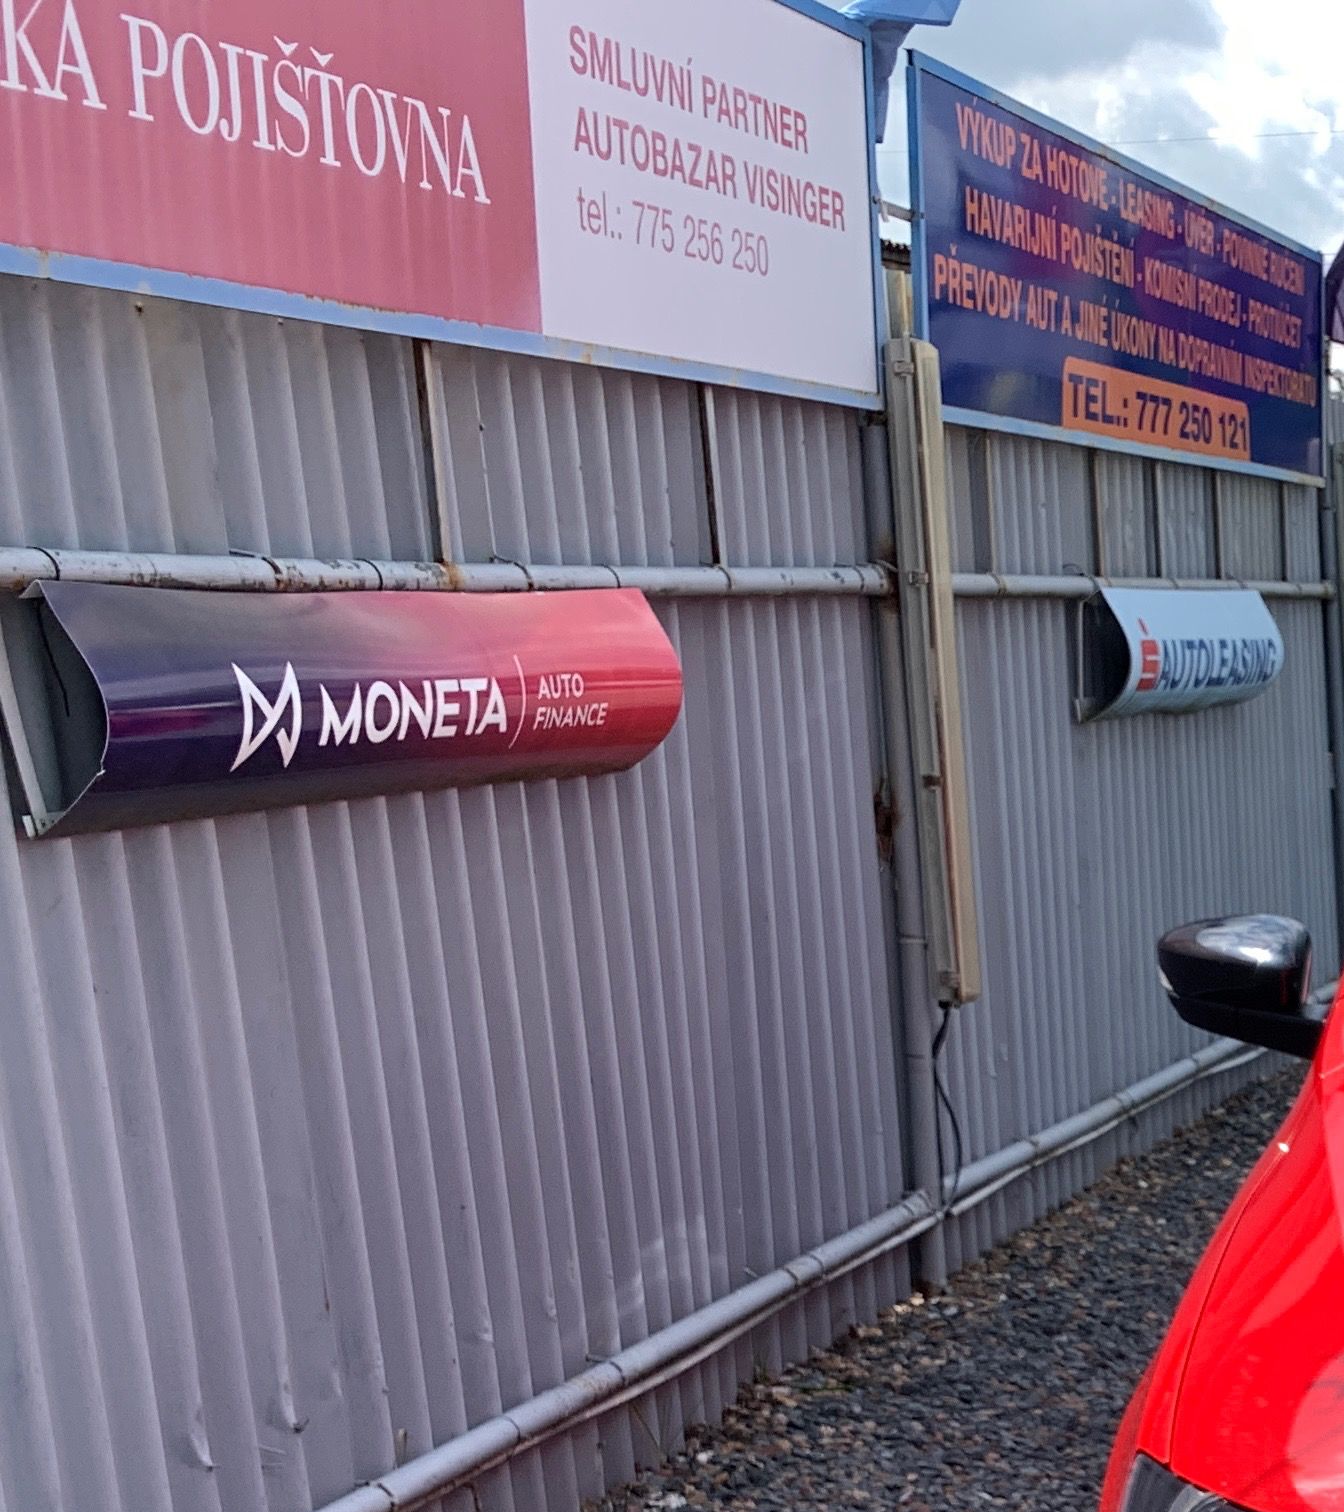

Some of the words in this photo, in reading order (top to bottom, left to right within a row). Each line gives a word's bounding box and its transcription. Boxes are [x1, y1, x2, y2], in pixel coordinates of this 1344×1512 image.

[120, 13, 491, 204] POJIŠŤOVNA
[569, 24, 694, 114] SMLUVNÍ
[702, 74, 809, 154] PARTNER
[574, 106, 738, 199] AUTOBAZAR
[743, 160, 846, 232] VISINGER
[955, 96, 1017, 170] VÝKUP
[1019, 132, 1044, 185] ZA
[1119, 178, 1175, 240] LEASING
[576, 186, 623, 241] tel.:
[632, 200, 675, 253] 775
[683, 214, 724, 265] 256
[731, 227, 769, 277] 250
[964, 185, 1058, 261] HAVARIJNÍ
[1061, 223, 1135, 289] POJIŠTĚNÍ
[933, 243, 1023, 323] PŘEVODY
[1025, 284, 1059, 334] AUT
[1061, 295, 1073, 338] A
[1075, 294, 1109, 348] JINÉ
[1110, 298, 1157, 361] ÚKONY
[1158, 325, 1177, 368] NA
[1068, 372, 1129, 429] TEL.:
[1135, 390, 1173, 436] 777
[1178, 400, 1213, 445] 250
[1218, 411, 1248, 452] 121
[318, 676, 508, 747] MONETA
[537, 673, 585, 700] AUTO
[1159, 637, 1278, 691] AUTOLEASING
[533, 702, 609, 731] FINANCE
